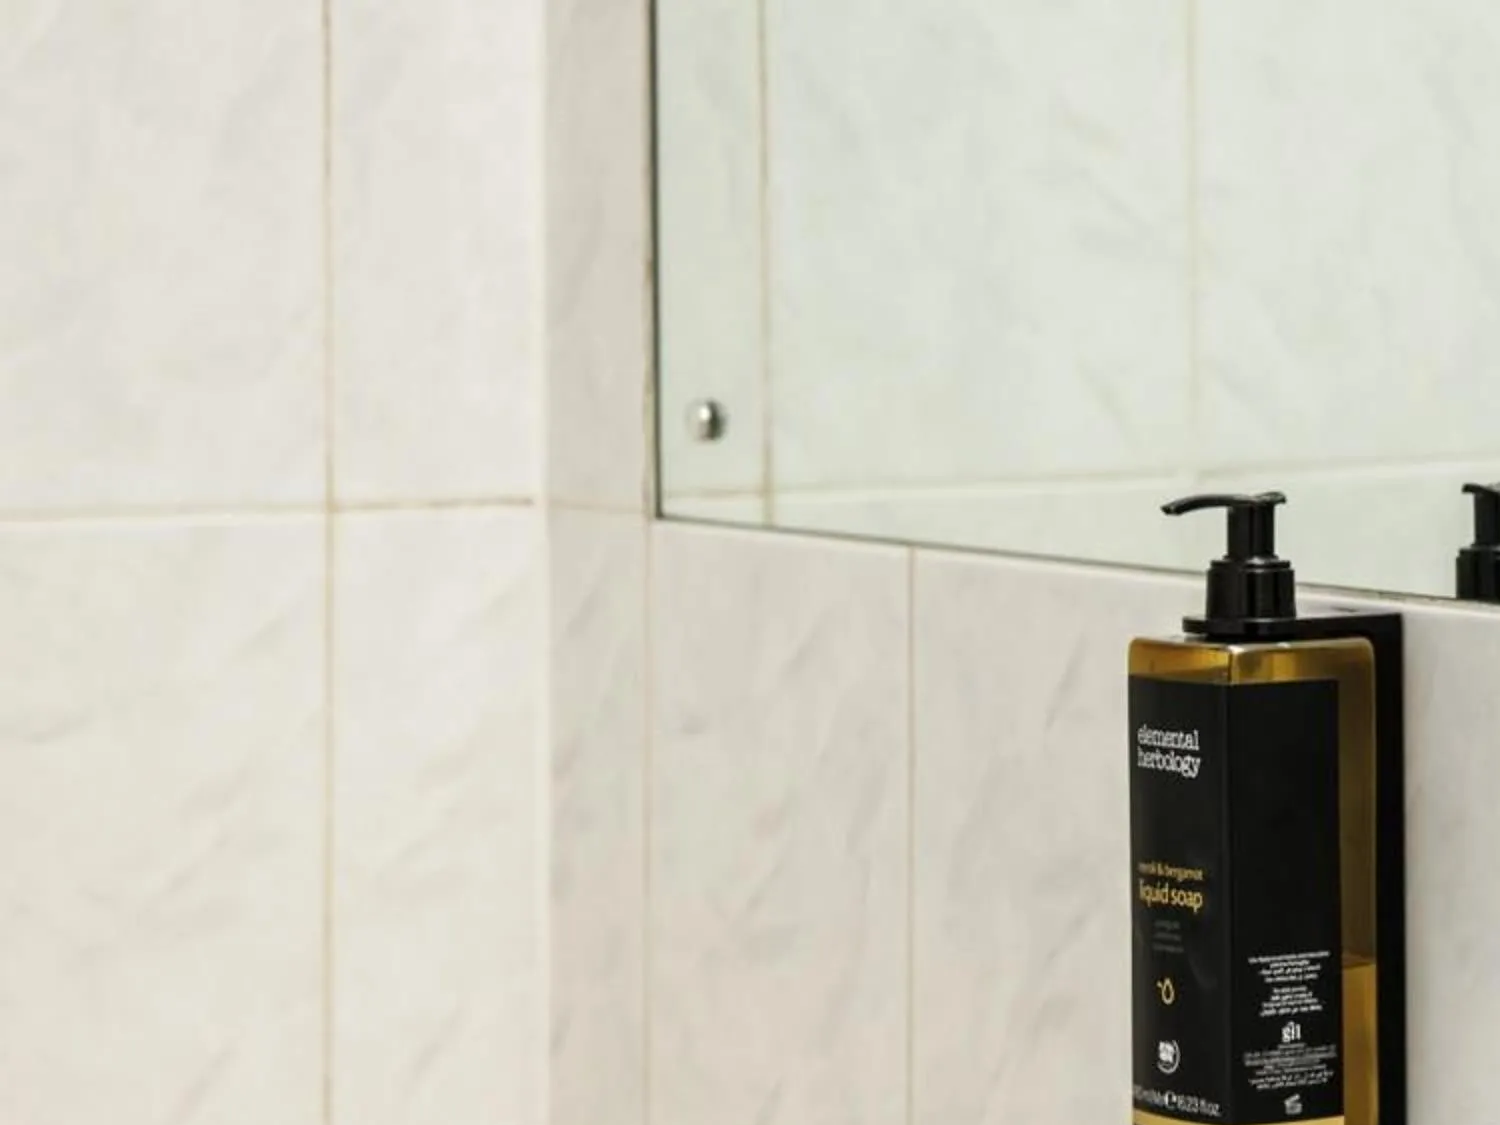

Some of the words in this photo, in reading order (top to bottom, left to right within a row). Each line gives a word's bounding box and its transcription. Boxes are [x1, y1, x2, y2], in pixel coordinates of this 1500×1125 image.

[1137, 724, 1200, 751] elemental
[1137, 745, 1201, 779] herbology
[1139, 878, 1169, 908] liquid
[1171, 888, 1203, 914] soap
